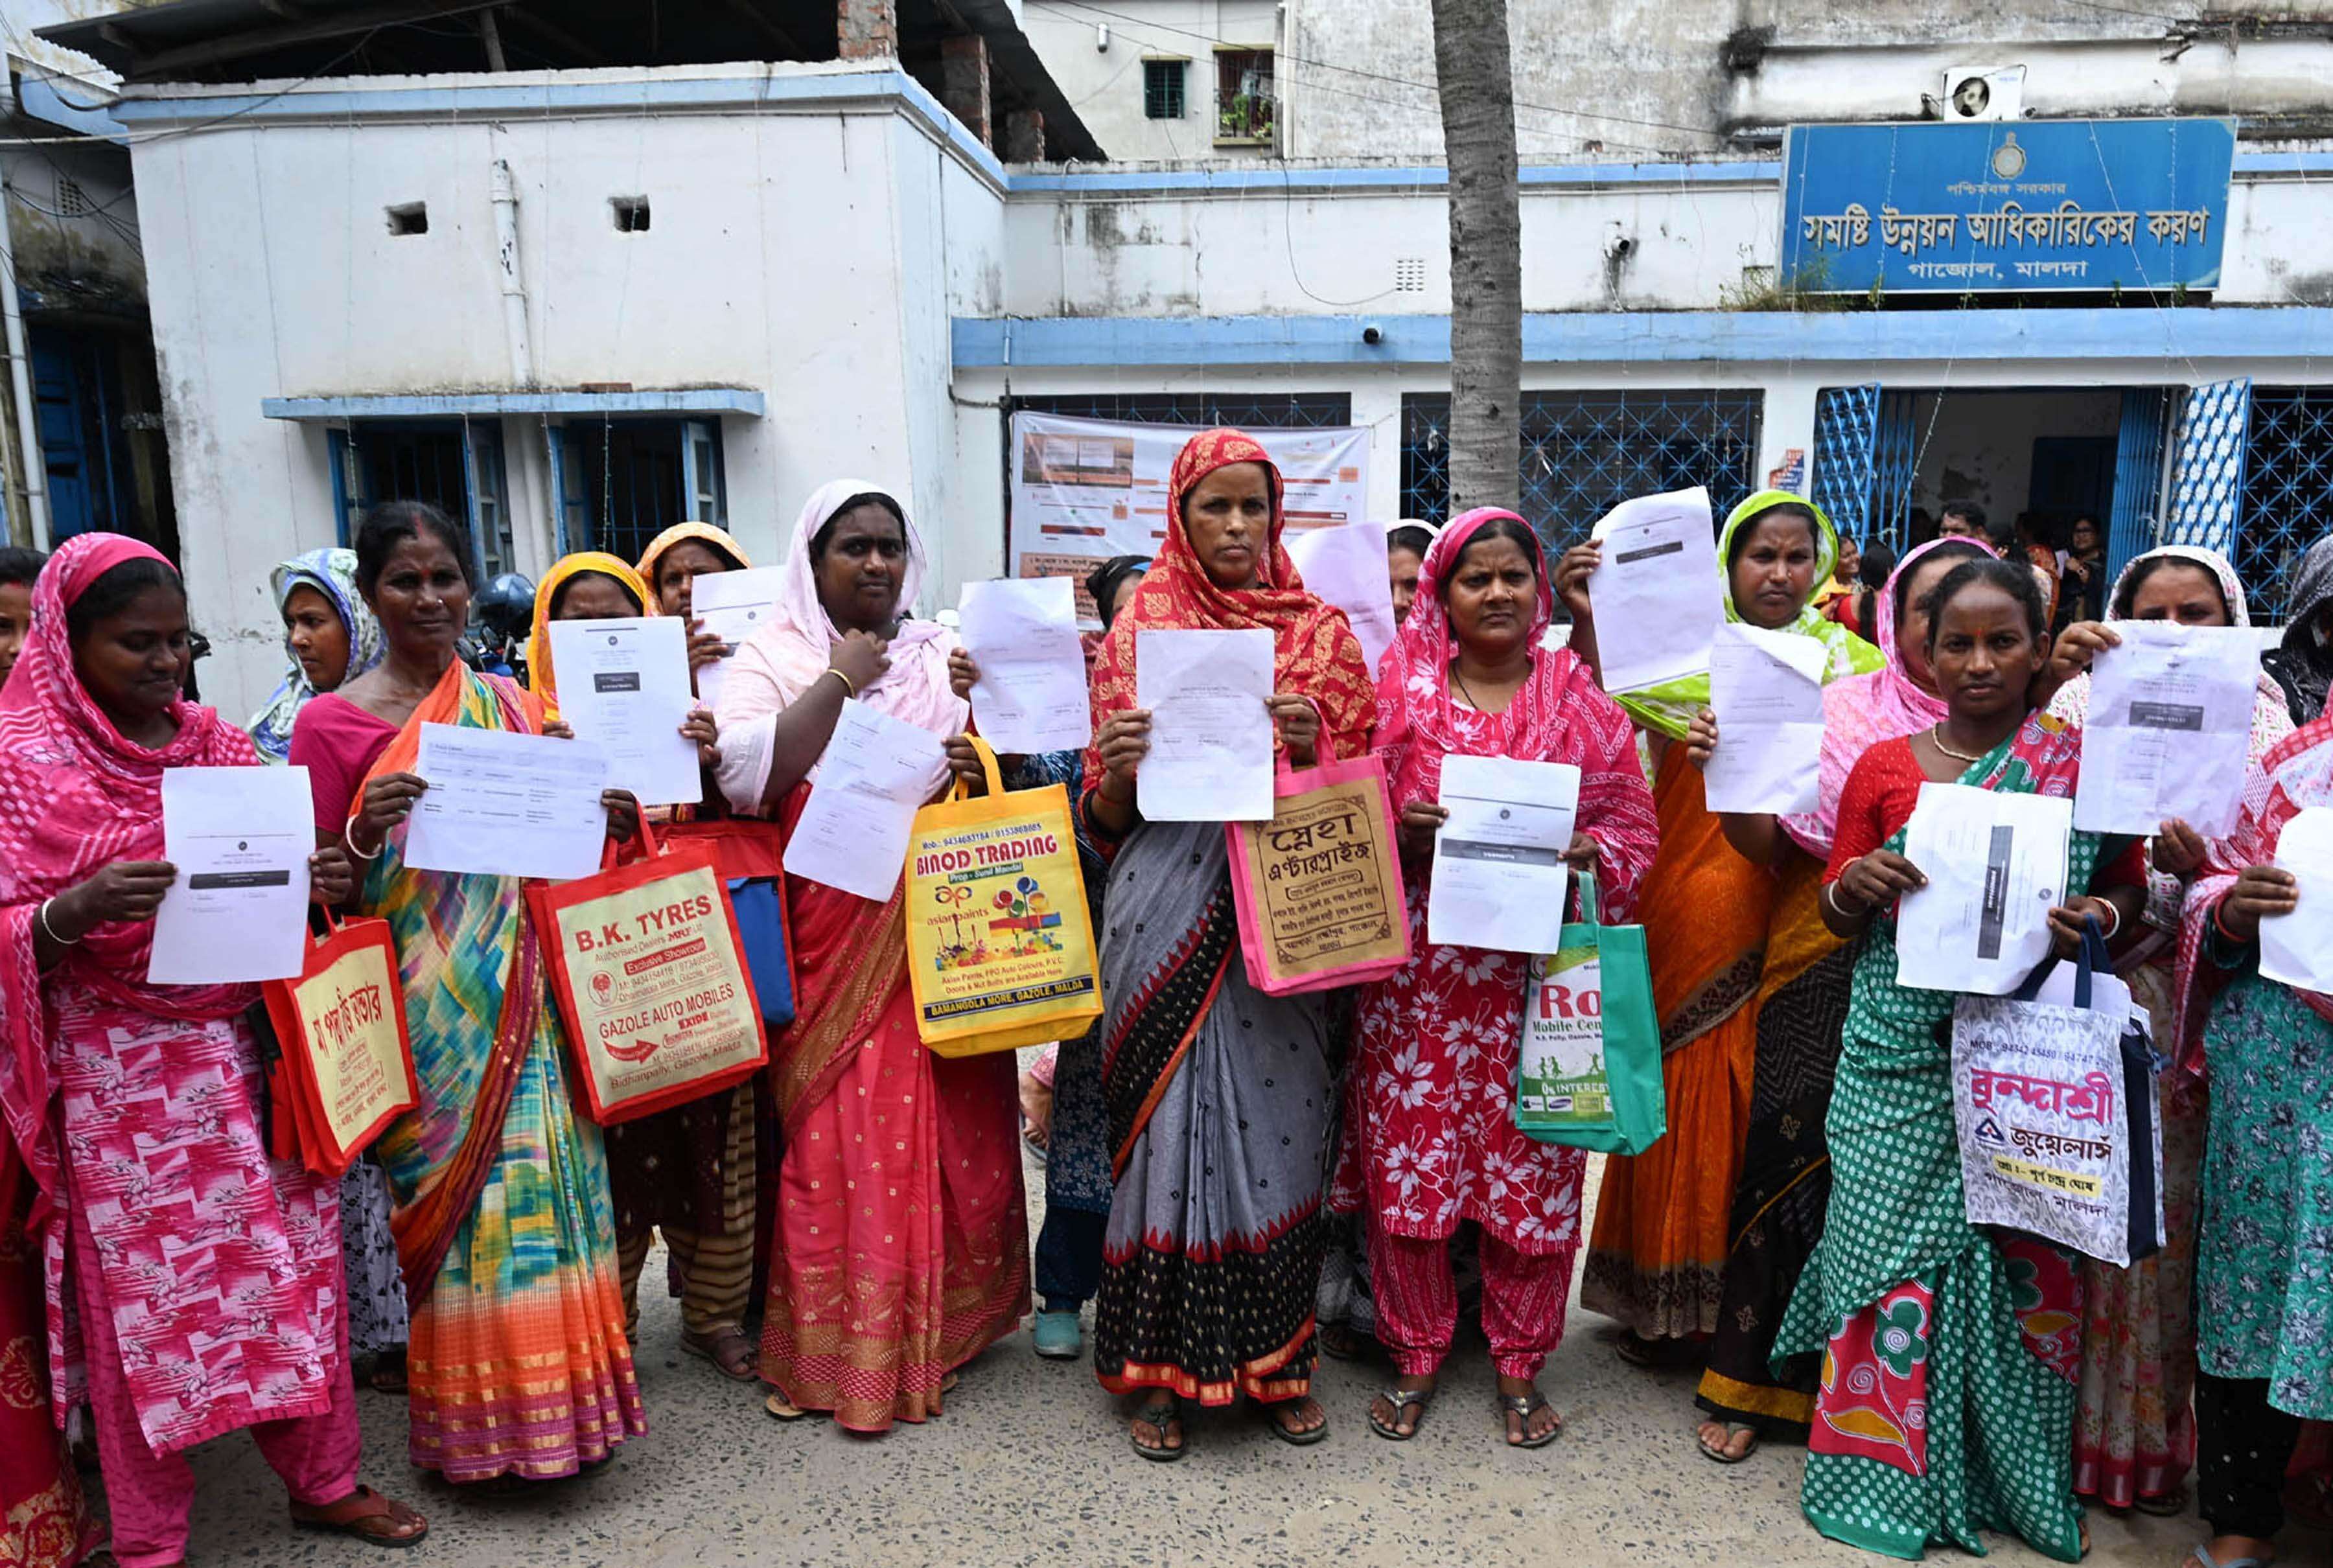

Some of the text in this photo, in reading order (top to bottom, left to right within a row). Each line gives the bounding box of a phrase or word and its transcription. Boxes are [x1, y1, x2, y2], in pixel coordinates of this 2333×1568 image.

[2015, 183, 2067, 194] সরকার
[1804, 200, 2211, 259] সমষ্টি উন্নয়ন আধিকারিকের করণ
[1908, 260, 2088, 280] গাজোল, মালদা
[916, 835, 1058, 877] BINOD TRADING
[575, 895, 712, 952] B.K. TYRES
[627, 952, 662, 973] Exclusive
[664, 940, 706, 960] Showroom
[1016, 986, 1053, 1003] GAZOLE,
[1055, 980, 1084, 993] MALDA
[599, 1010, 650, 1040] GAZOLE
[653, 998, 683, 1024] AUTO
[686, 984, 735, 1015] MOBILES
[678, 1012, 709, 1030] EXIDE
[1533, 1021, 1573, 1032] Mobile
[1970, 1068, 2115, 1127] বৃন্দাশ্রী
[2010, 1126, 2113, 1162] জুয়েলার্স
